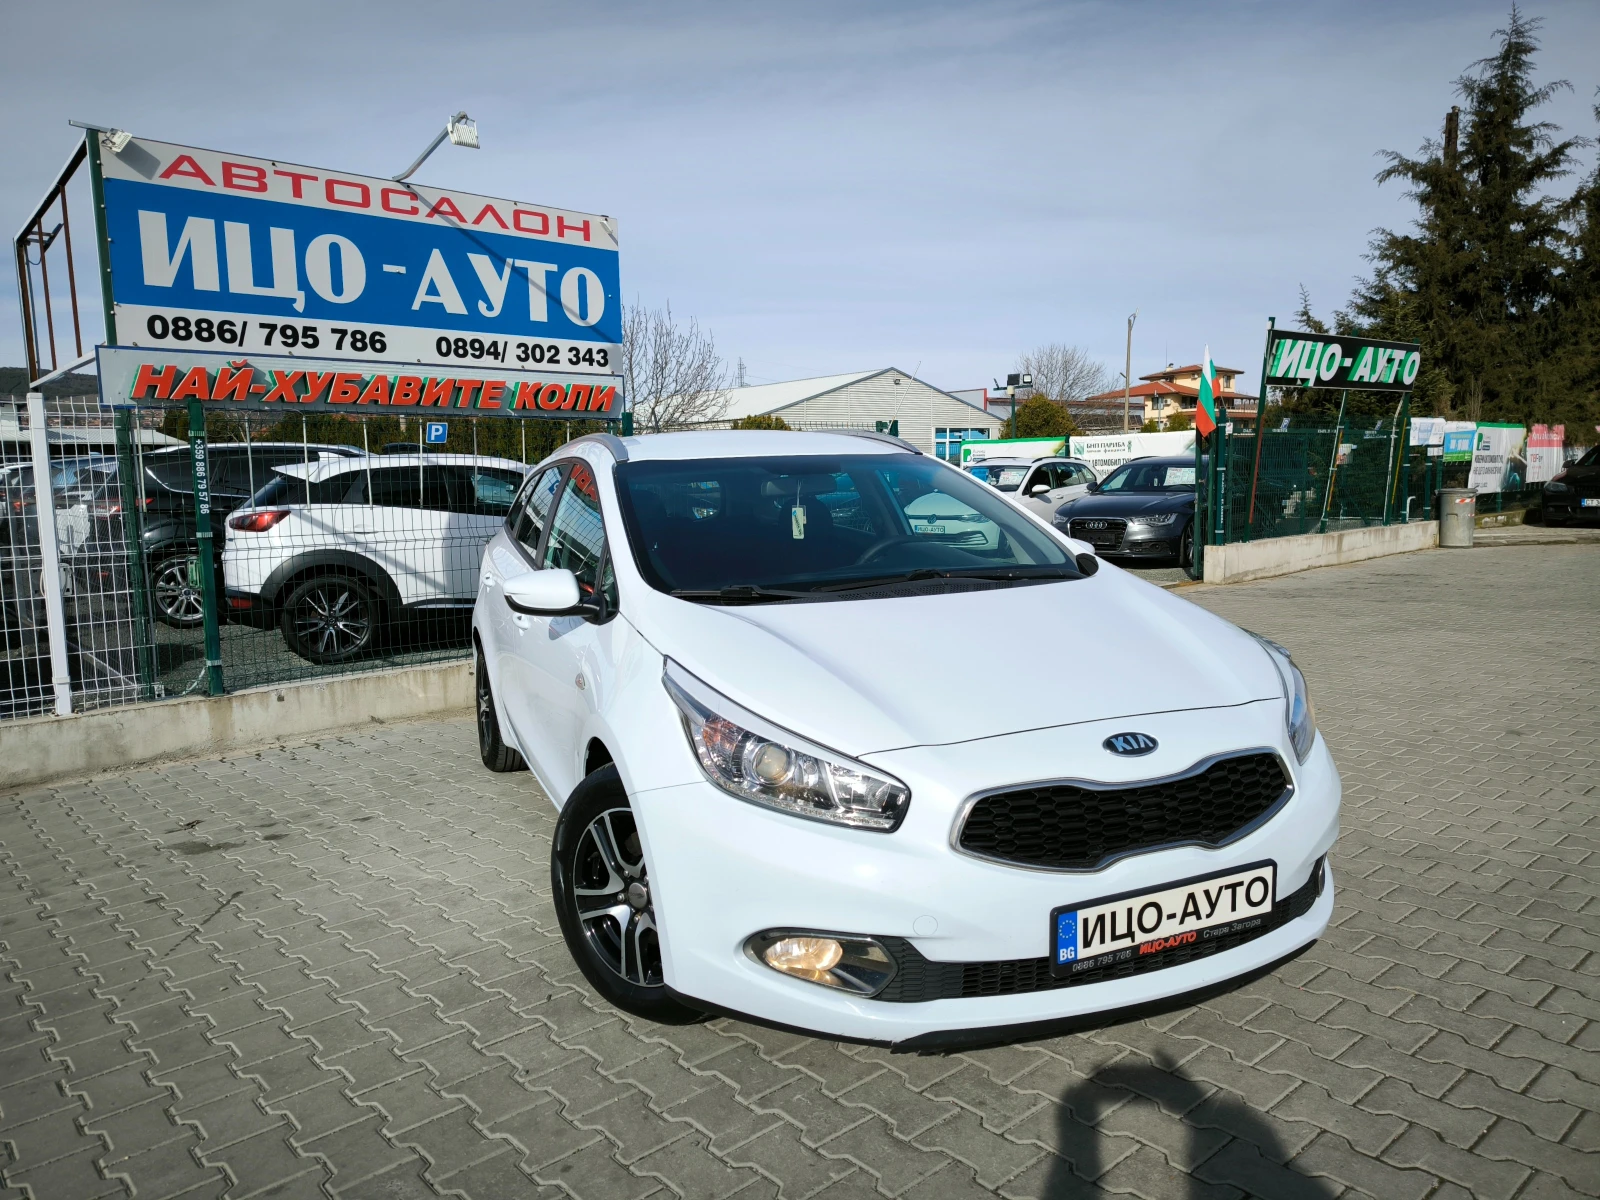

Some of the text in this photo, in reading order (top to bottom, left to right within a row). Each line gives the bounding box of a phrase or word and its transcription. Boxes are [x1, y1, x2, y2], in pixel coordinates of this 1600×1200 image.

[158, 154, 591, 242] АВТОСАЛОН
[147, 314, 387, 353] 0886/ 795 786
[436, 336, 609, 368] 0894/ 302 343
[130, 359, 616, 412] НАЙ-ХУБАВИТЕ КОЛИ
[1272, 338, 1421, 387] ИЦО-АУТО
[194, 438, 210, 514] +359 886 79 57 86
[1109, 732, 1154, 752] KIA
[1082, 875, 1269, 950] ИЦО-АУТО
[1059, 946, 1075, 962] BG
[1072, 917, 1262, 972] 0886 795 786 ИЦО-АУТО Стара Загора
